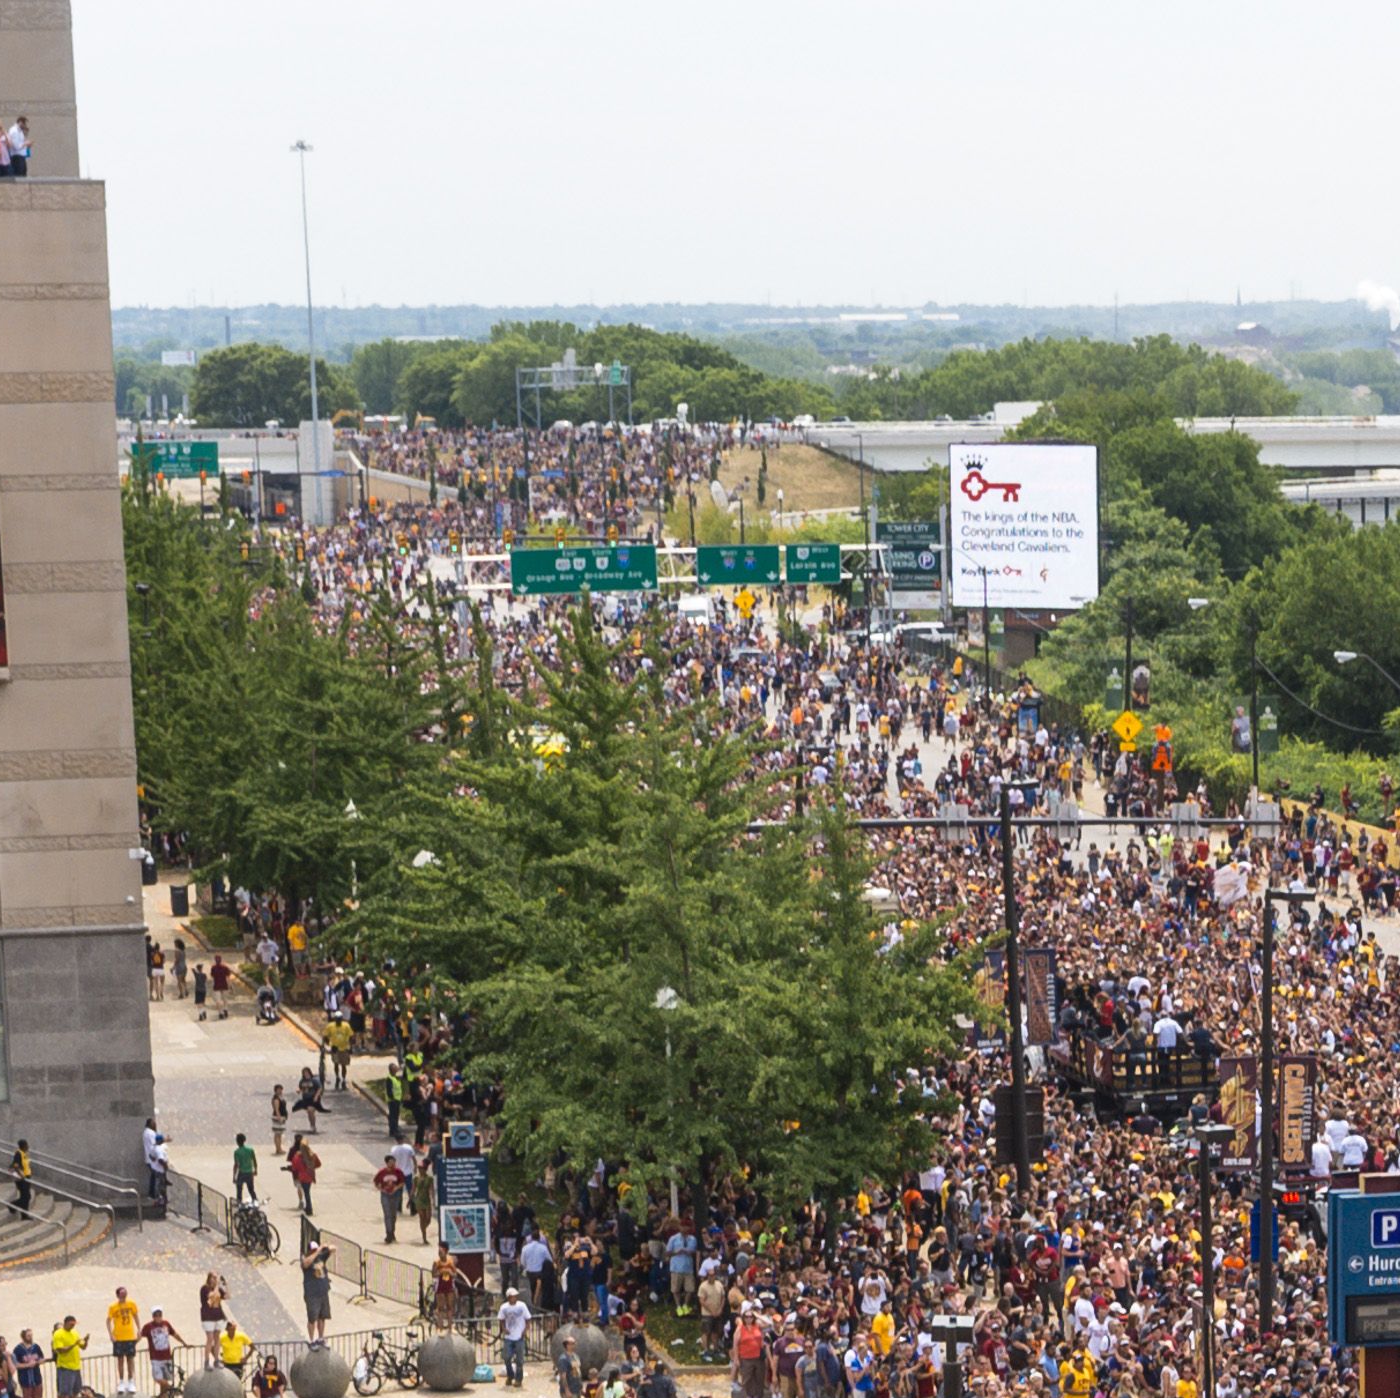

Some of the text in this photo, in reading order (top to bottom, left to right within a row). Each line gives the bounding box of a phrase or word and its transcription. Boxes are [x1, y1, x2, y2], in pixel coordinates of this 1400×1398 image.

[962, 511, 982, 522] The
[985, 511, 1013, 525] kings
[1017, 511, 1028, 522] of
[1031, 511, 1049, 522] the
[913, 524, 929, 532] CITY
[961, 525, 1084, 539] Congratulations to the
[962, 540, 1015, 552] Cleveland
[1284, 1064, 1305, 1163] CAVALIERS
